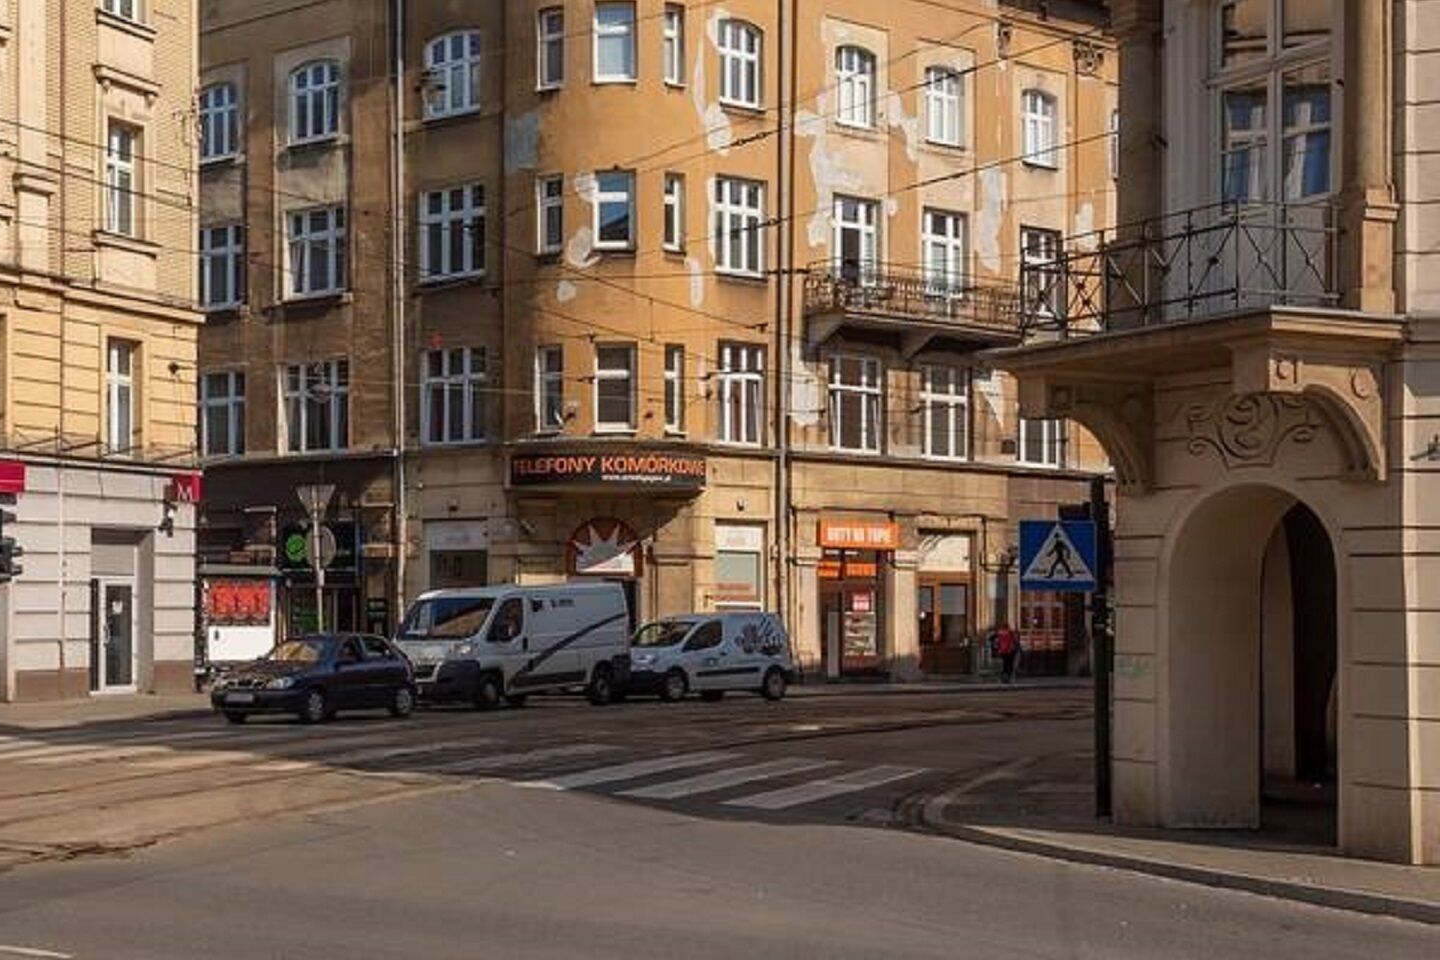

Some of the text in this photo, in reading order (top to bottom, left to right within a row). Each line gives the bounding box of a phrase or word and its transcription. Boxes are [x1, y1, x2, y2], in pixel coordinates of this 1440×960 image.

[514, 452, 705, 476] TELEFONY KOMÓRKOWE
[176, 480, 193, 502] M
